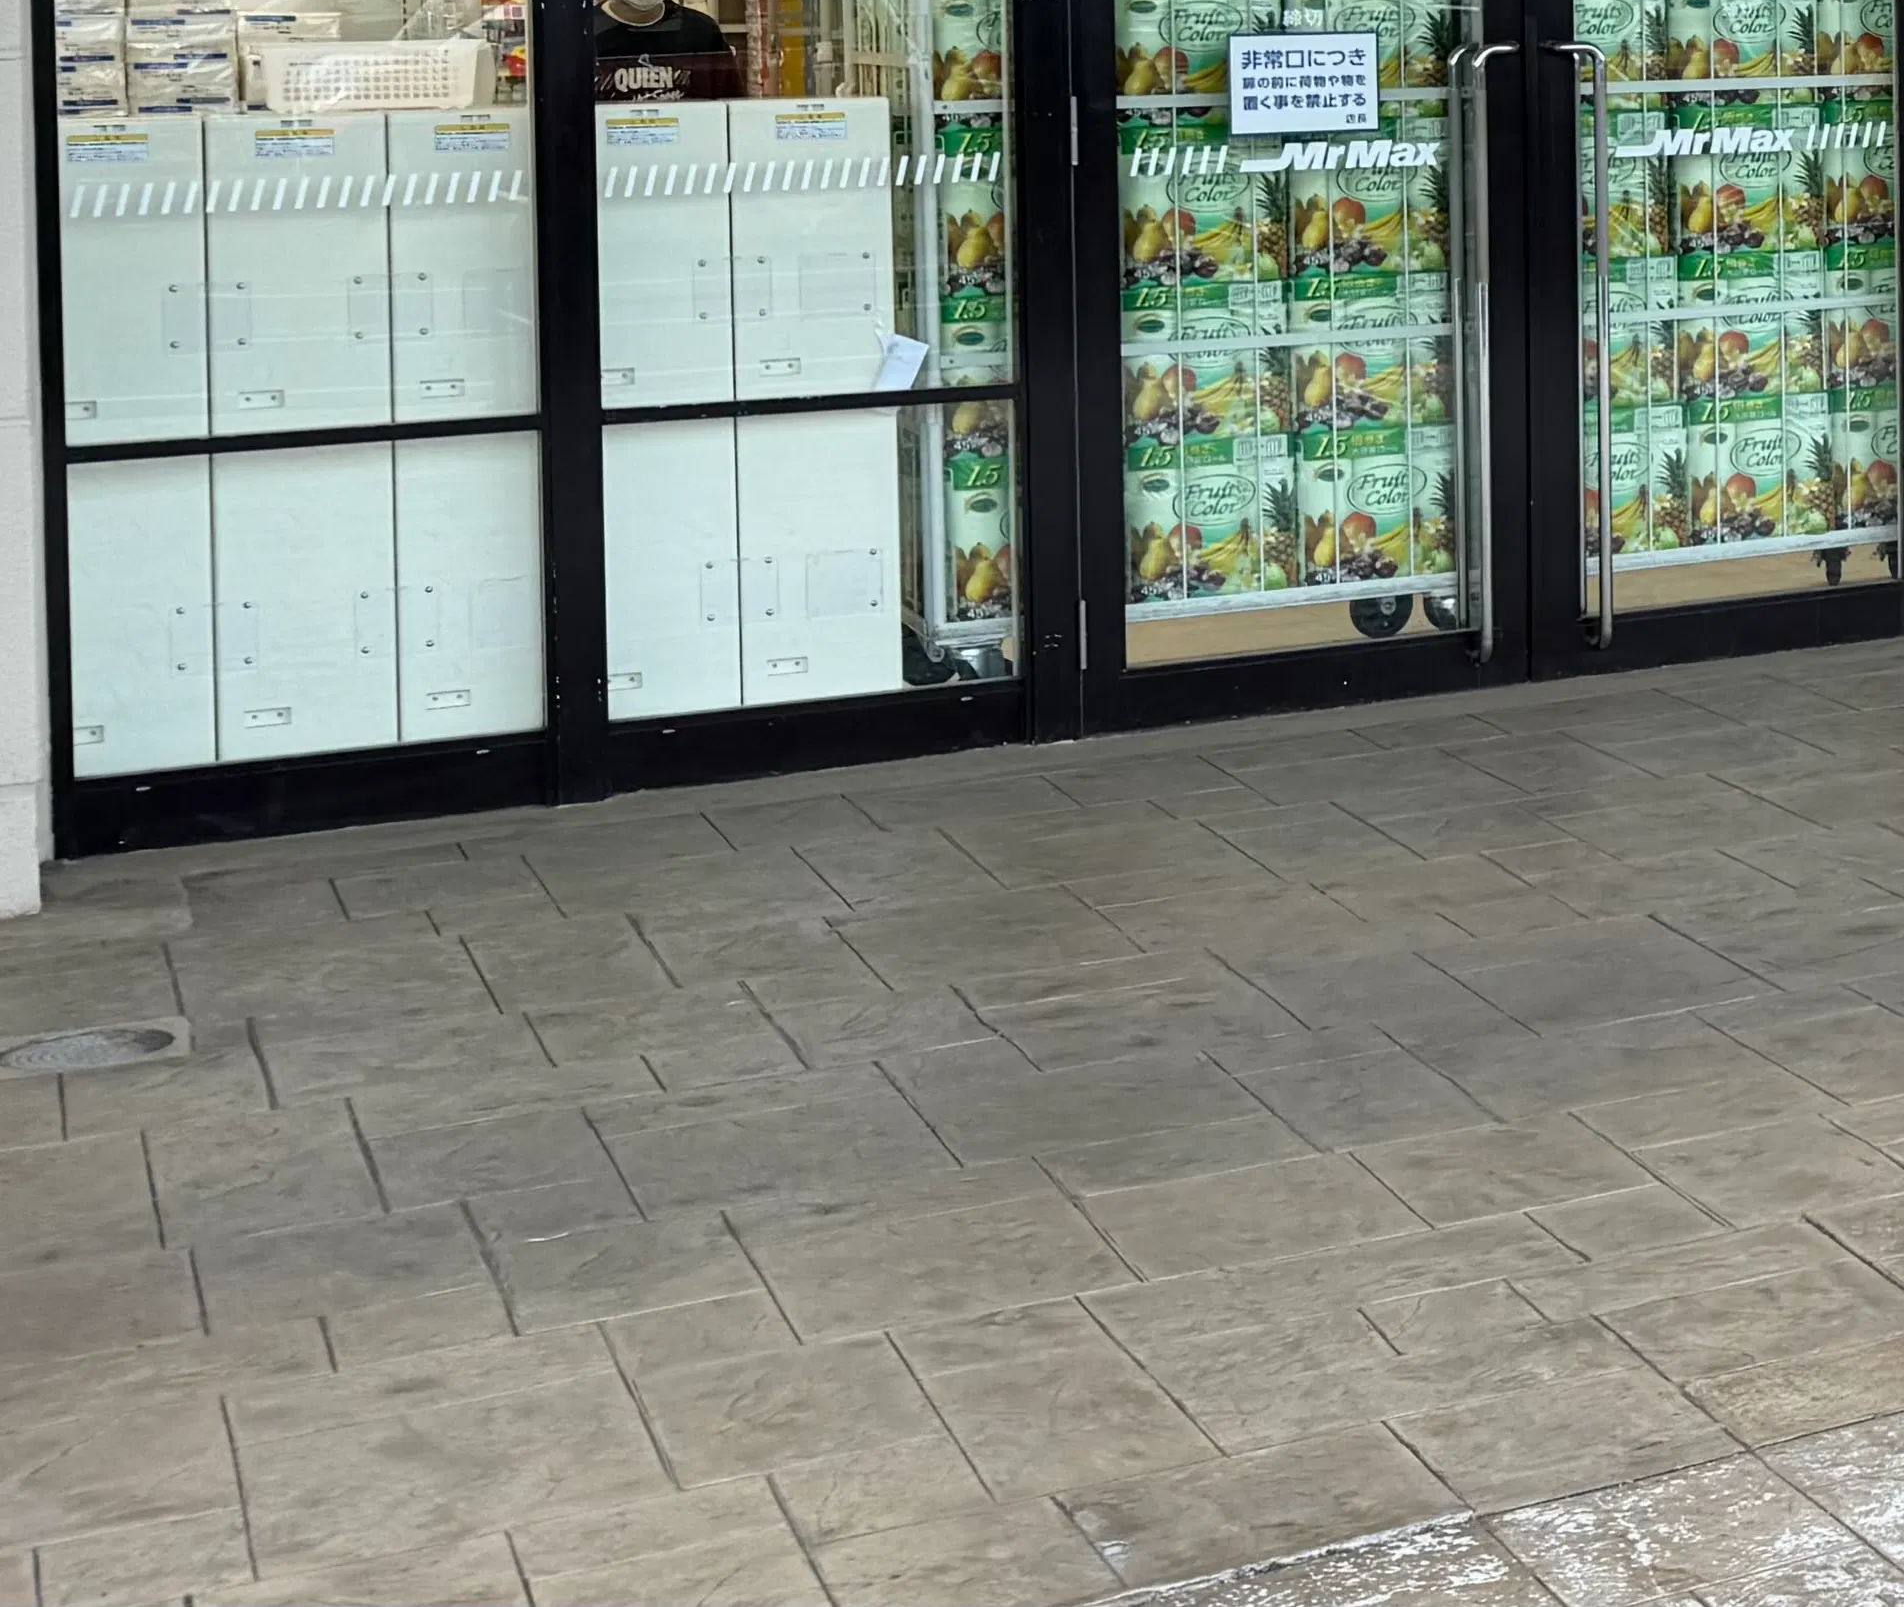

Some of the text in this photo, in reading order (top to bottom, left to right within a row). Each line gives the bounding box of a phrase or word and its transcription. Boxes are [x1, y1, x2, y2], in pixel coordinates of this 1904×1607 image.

[1176, 22, 1231, 43] Color
[1730, 19, 1775, 36] Color
[1241, 48, 1367, 70] 非常口につき
[1615, 125, 1796, 158] MrMax
[1239, 139, 1442, 174] MrMax
[1735, 164, 1778, 180] Color
[1184, 178, 1236, 202] Color
[1354, 174, 1402, 193] Color
[1134, 285, 1168, 308] 1.5
[1139, 445, 1175, 468] 1.5
[1313, 433, 1350, 458] 1.5
[964, 464, 1000, 487] 1.5
[1184, 481, 1244, 503] Fruits
[1191, 497, 1239, 517] Color
